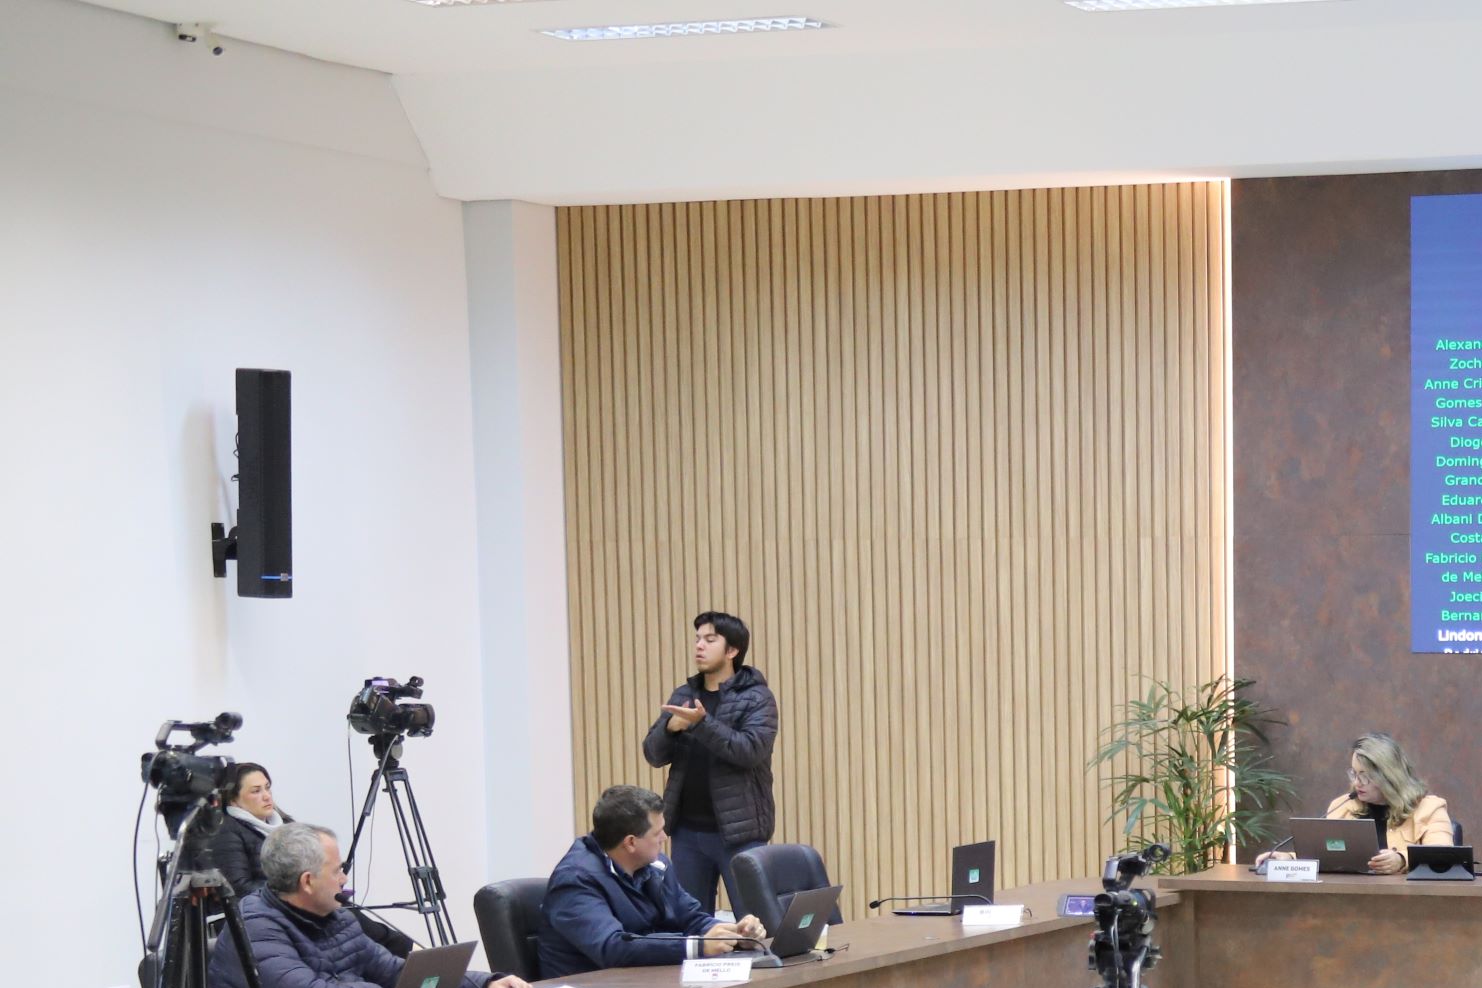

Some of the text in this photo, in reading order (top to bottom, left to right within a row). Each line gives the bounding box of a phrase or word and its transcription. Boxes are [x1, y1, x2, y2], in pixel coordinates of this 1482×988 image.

[1425, 379, 1458, 389] Anne
[1436, 398, 1482, 408] Gomes
[1432, 416, 1462, 427] Silva
[1432, 513, 1472, 524] Albani
[1426, 553, 1476, 563] Fabricio
[1442, 572, 1458, 582] de
